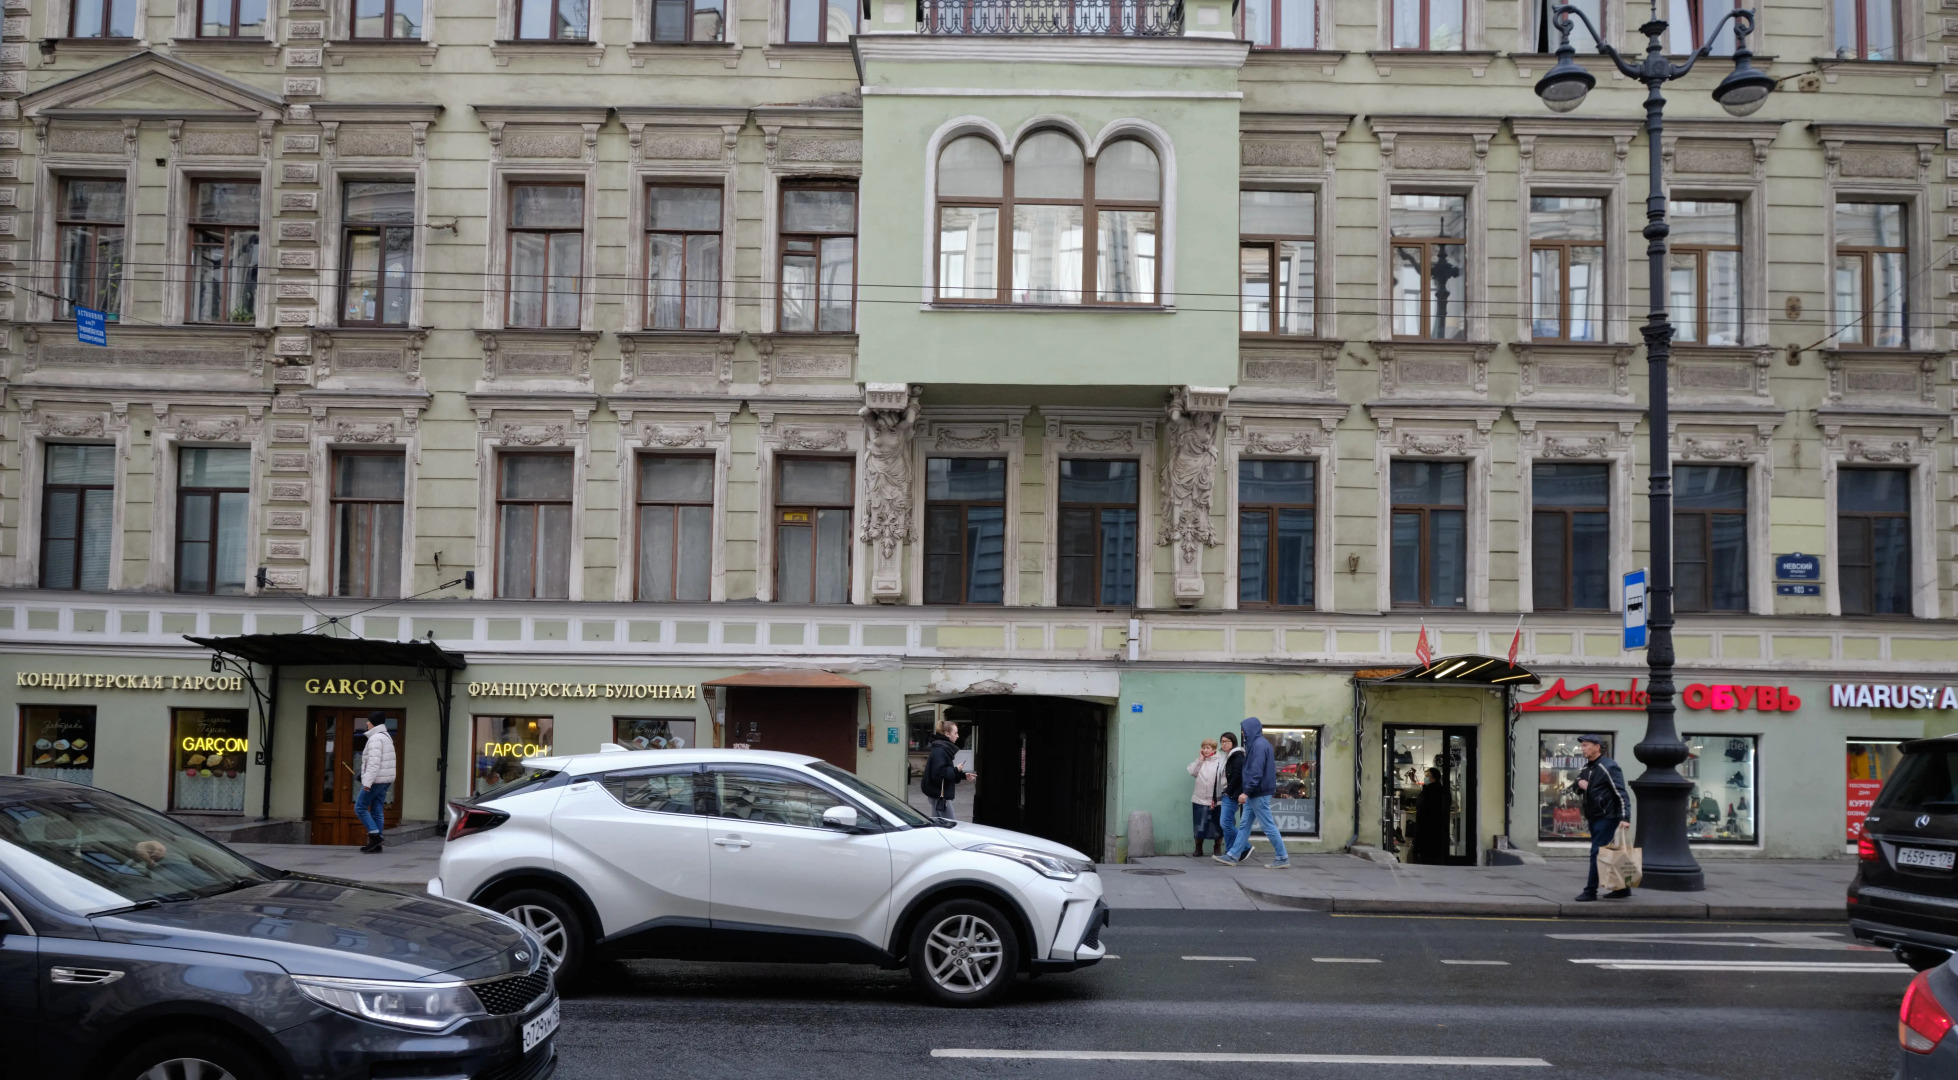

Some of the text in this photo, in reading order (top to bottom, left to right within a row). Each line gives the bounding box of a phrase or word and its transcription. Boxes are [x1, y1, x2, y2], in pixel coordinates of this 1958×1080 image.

[1783, 562, 1813, 570] НЕВСКИЙ
[1793, 586, 1805, 594] 103
[16, 672, 242, 691] КОНДИТЕРСКАЯ ГАРСОН
[305, 678, 405, 700] GARÇON
[467, 681, 697, 699] ФРАНЦУЗСКАЯ БУЛОЧНАЯ
[1682, 683, 1802, 711] ОБУВЬ
[1829, 683, 1958, 709] MARUSYA
[182, 736, 249, 756] GARÇON
[484, 742, 548, 758] ГАРСОН
